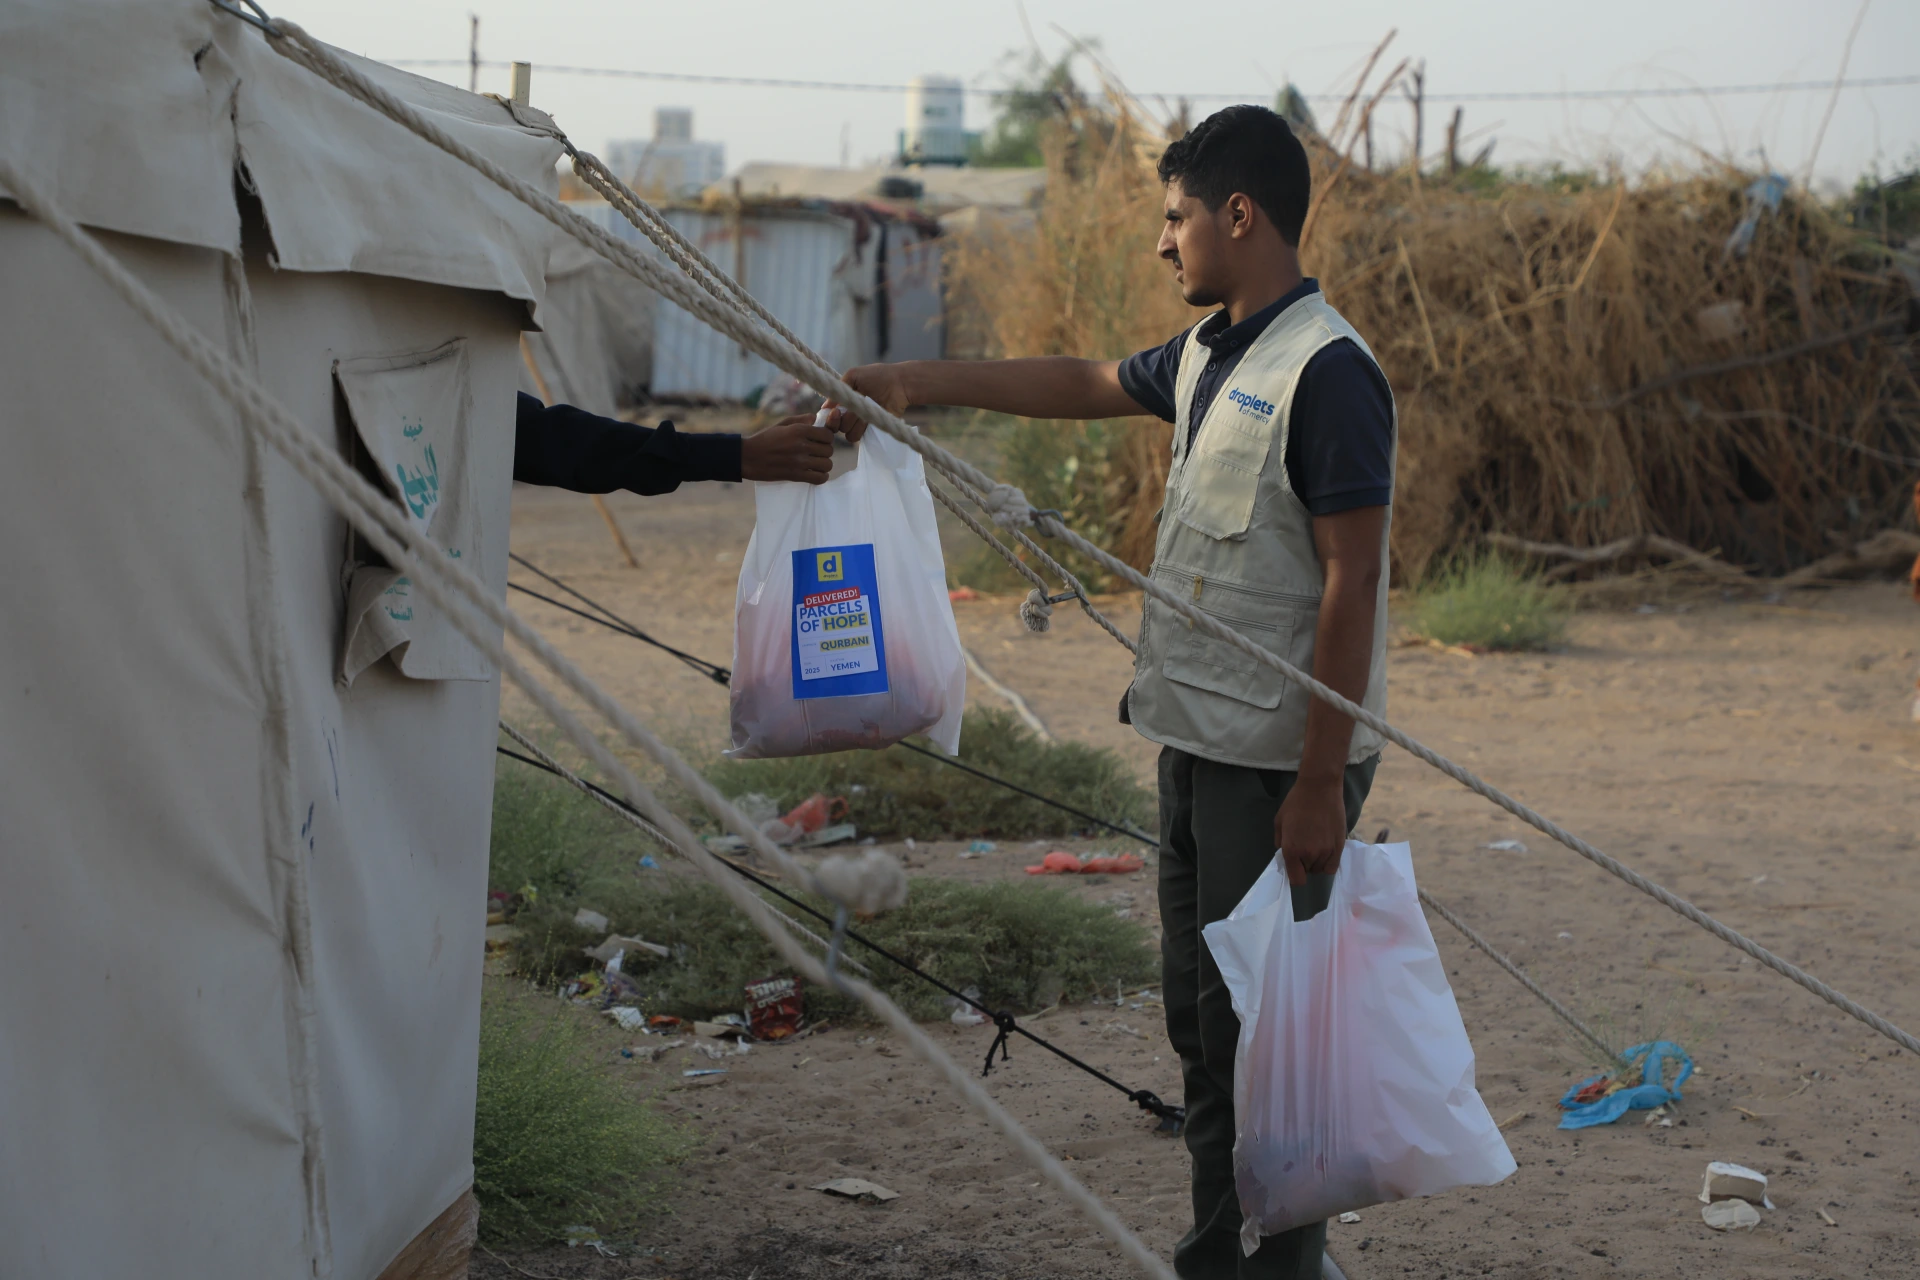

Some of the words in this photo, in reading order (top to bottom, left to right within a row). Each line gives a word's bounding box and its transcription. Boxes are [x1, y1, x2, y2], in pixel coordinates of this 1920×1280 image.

[1228, 387, 1275, 416] droplets
[1250, 412, 1270, 425] mercy
[822, 555, 837, 573] d
[805, 588, 858, 606] DELIVERED!
[799, 600, 863, 620] PARCELS
[801, 620, 819, 632] OF
[823, 613, 867, 631] HOPE
[821, 636, 869, 650] QURBANI
[830, 660, 861, 672] YEMEN
